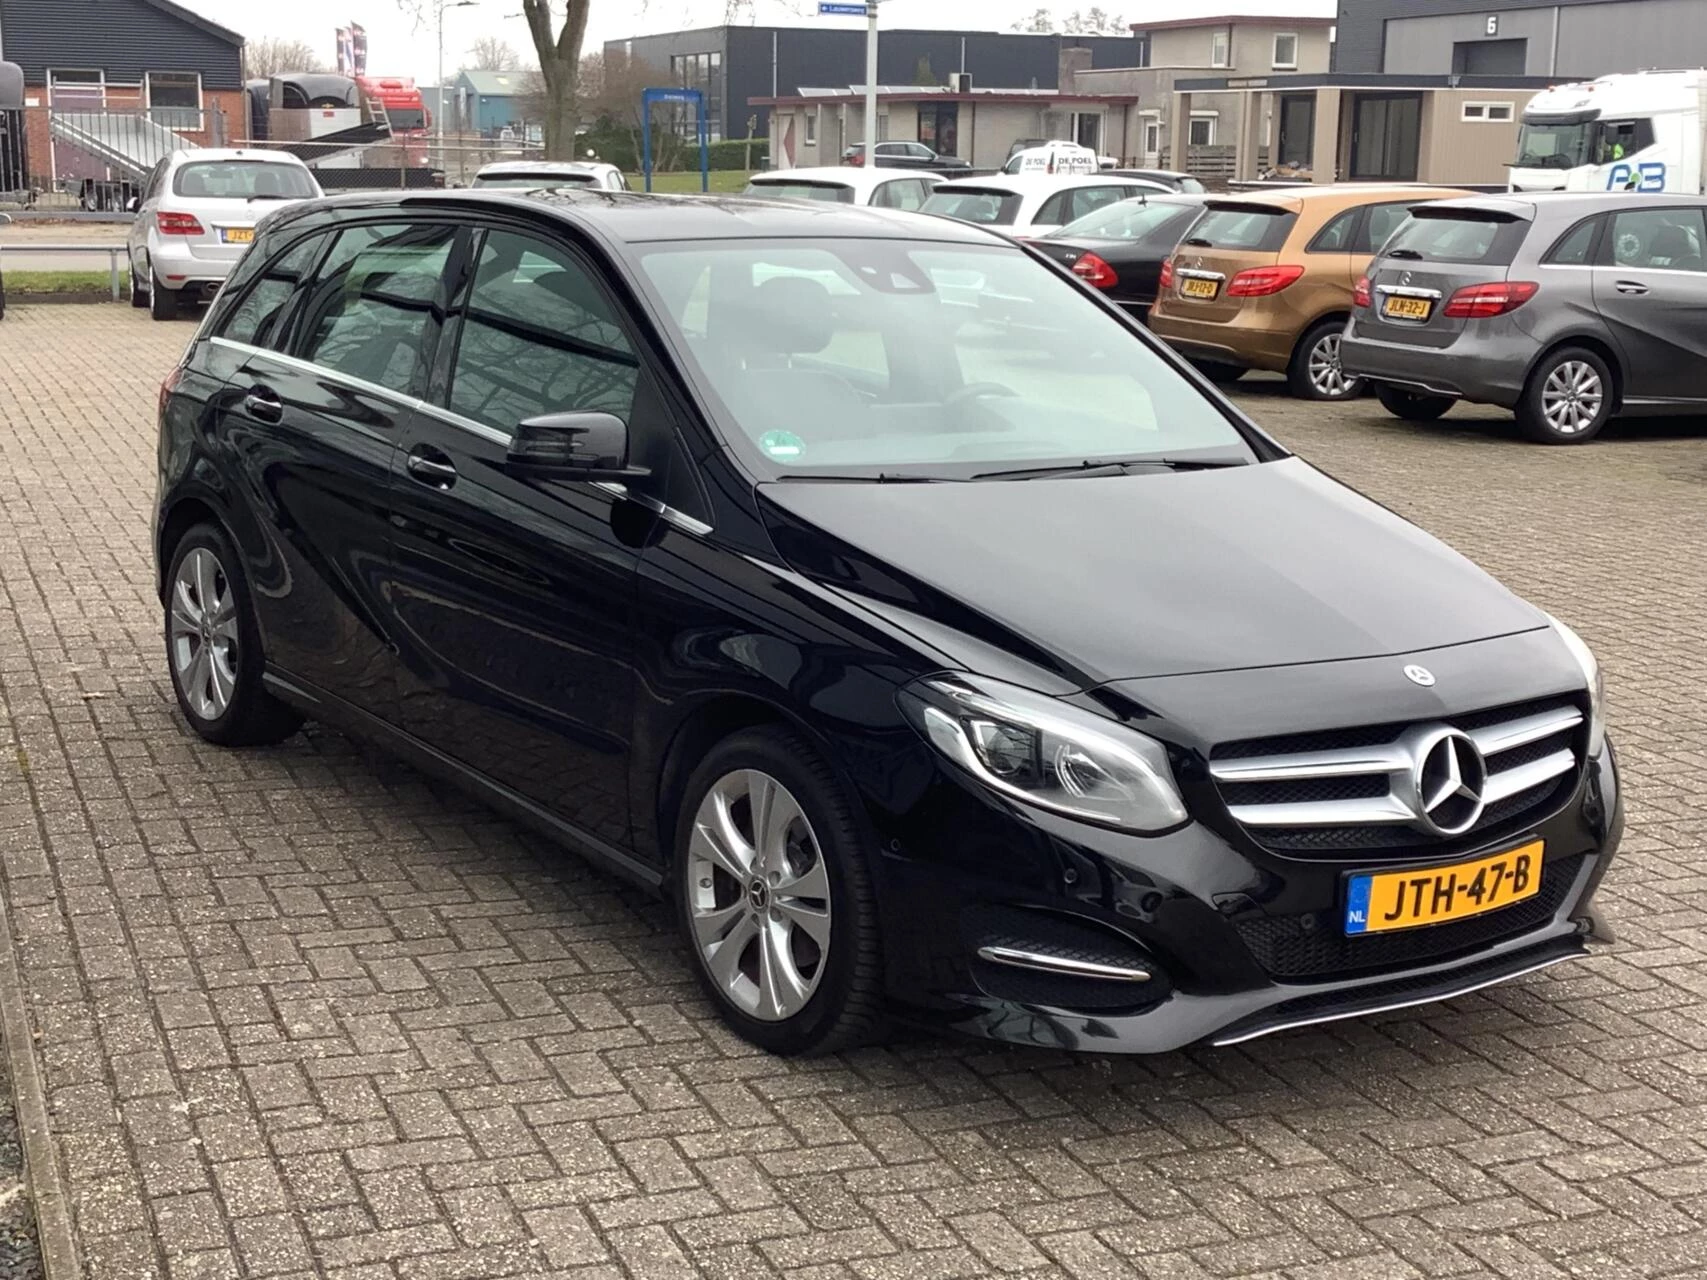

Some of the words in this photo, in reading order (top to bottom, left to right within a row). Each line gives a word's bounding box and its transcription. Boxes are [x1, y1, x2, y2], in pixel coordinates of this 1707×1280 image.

[1487, 16, 1497, 34] 6
[1072, 157, 1092, 165] POEL
[1389, 299, 1426, 315] JLN-32-J
[1384, 854, 1531, 921] JTH-47-B
[1348, 910, 1365, 923] NL
